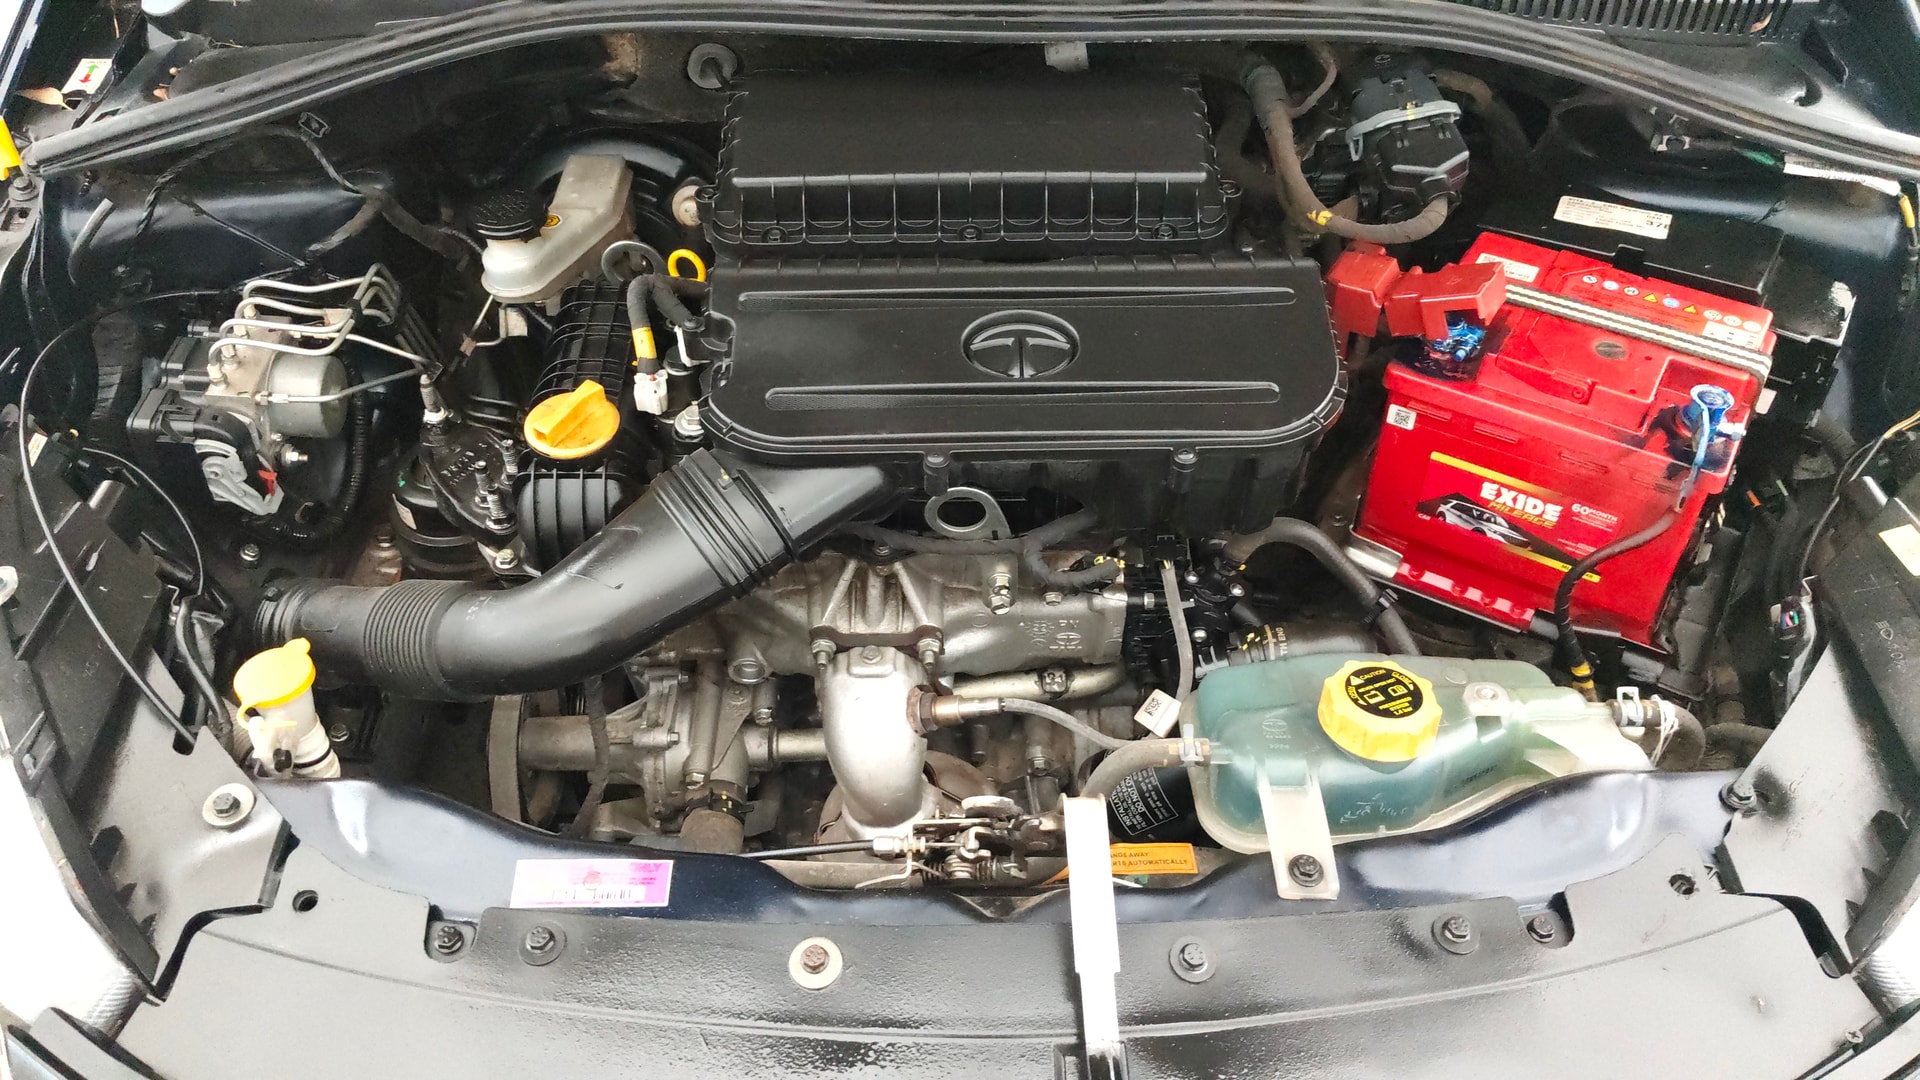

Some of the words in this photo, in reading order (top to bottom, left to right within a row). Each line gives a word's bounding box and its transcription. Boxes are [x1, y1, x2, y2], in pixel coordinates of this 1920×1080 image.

[1480, 482, 1563, 523] EXIDE
[1488, 501, 1557, 529] MILEAGE
[1572, 504, 1589, 515] 60
[1589, 509, 1618, 521] MONTH
[1360, 669, 1386, 680] CAUTION
[1391, 672, 1413, 685] CLOSE
[1128, 786, 1139, 801] NOT
[1135, 802, 1144, 812] DO
